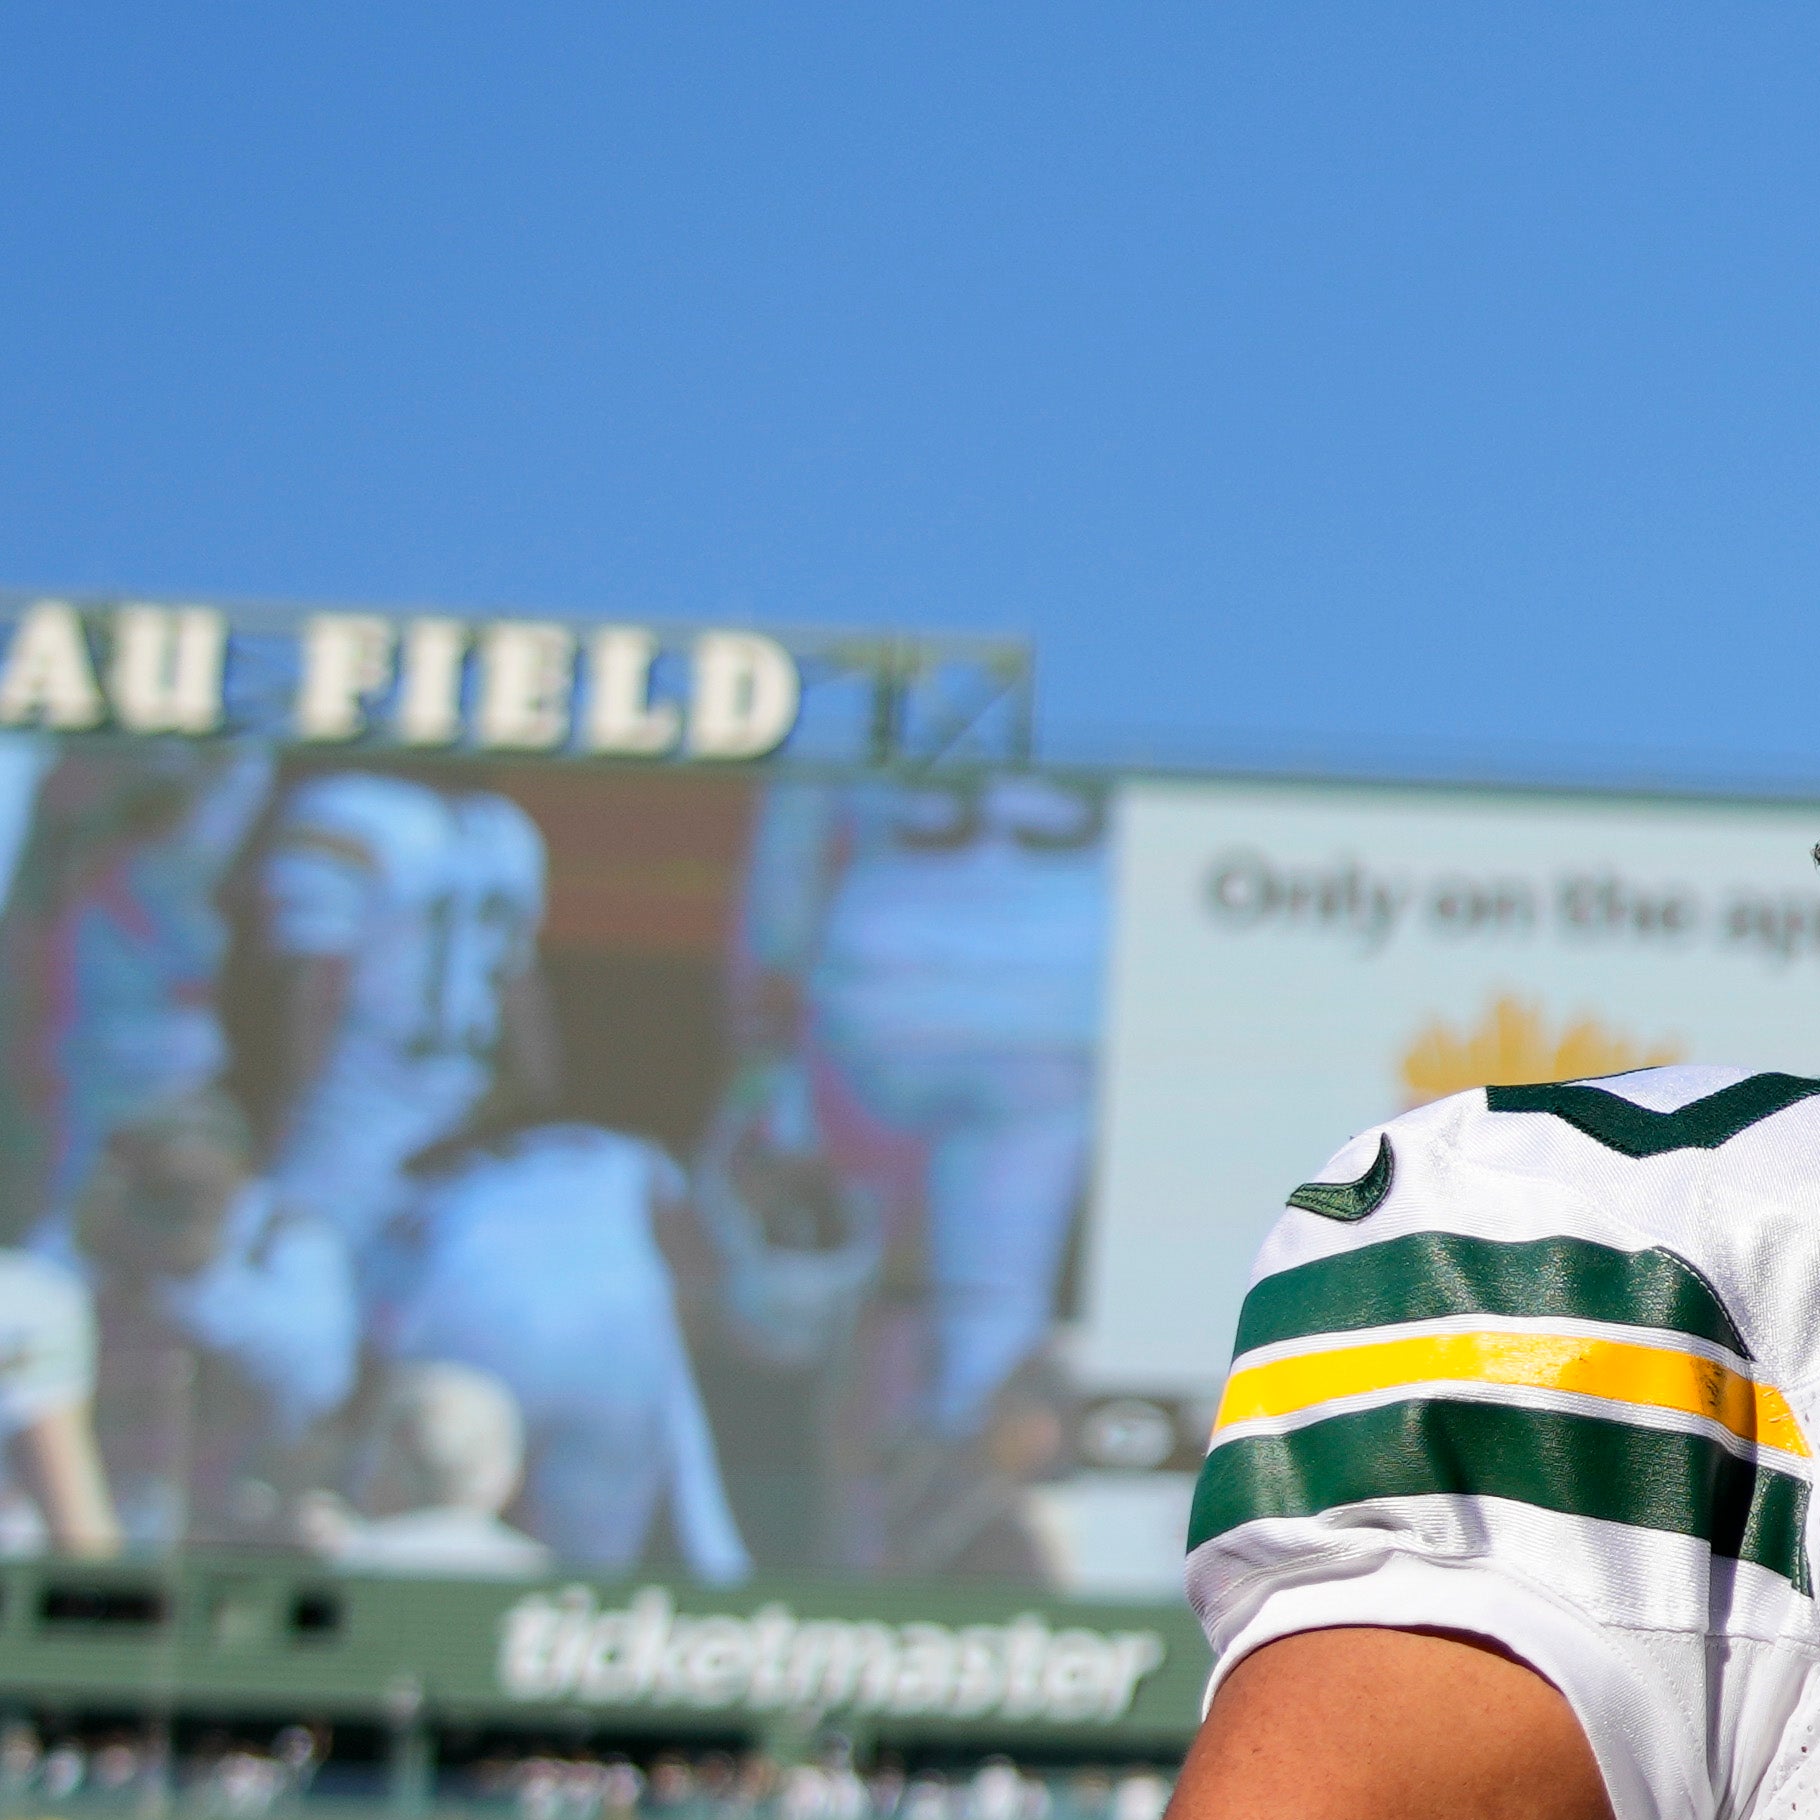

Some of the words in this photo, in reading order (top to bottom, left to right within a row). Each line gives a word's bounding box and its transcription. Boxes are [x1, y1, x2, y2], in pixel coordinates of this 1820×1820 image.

[0, 600, 226, 735] AU
[299, 611, 798, 759] FIELD
[1206, 848, 1397, 956] Only
[1424, 870, 1537, 940] on
[1553, 862, 1701, 944] the
[503, 1588, 1166, 1722] ticketmaster
